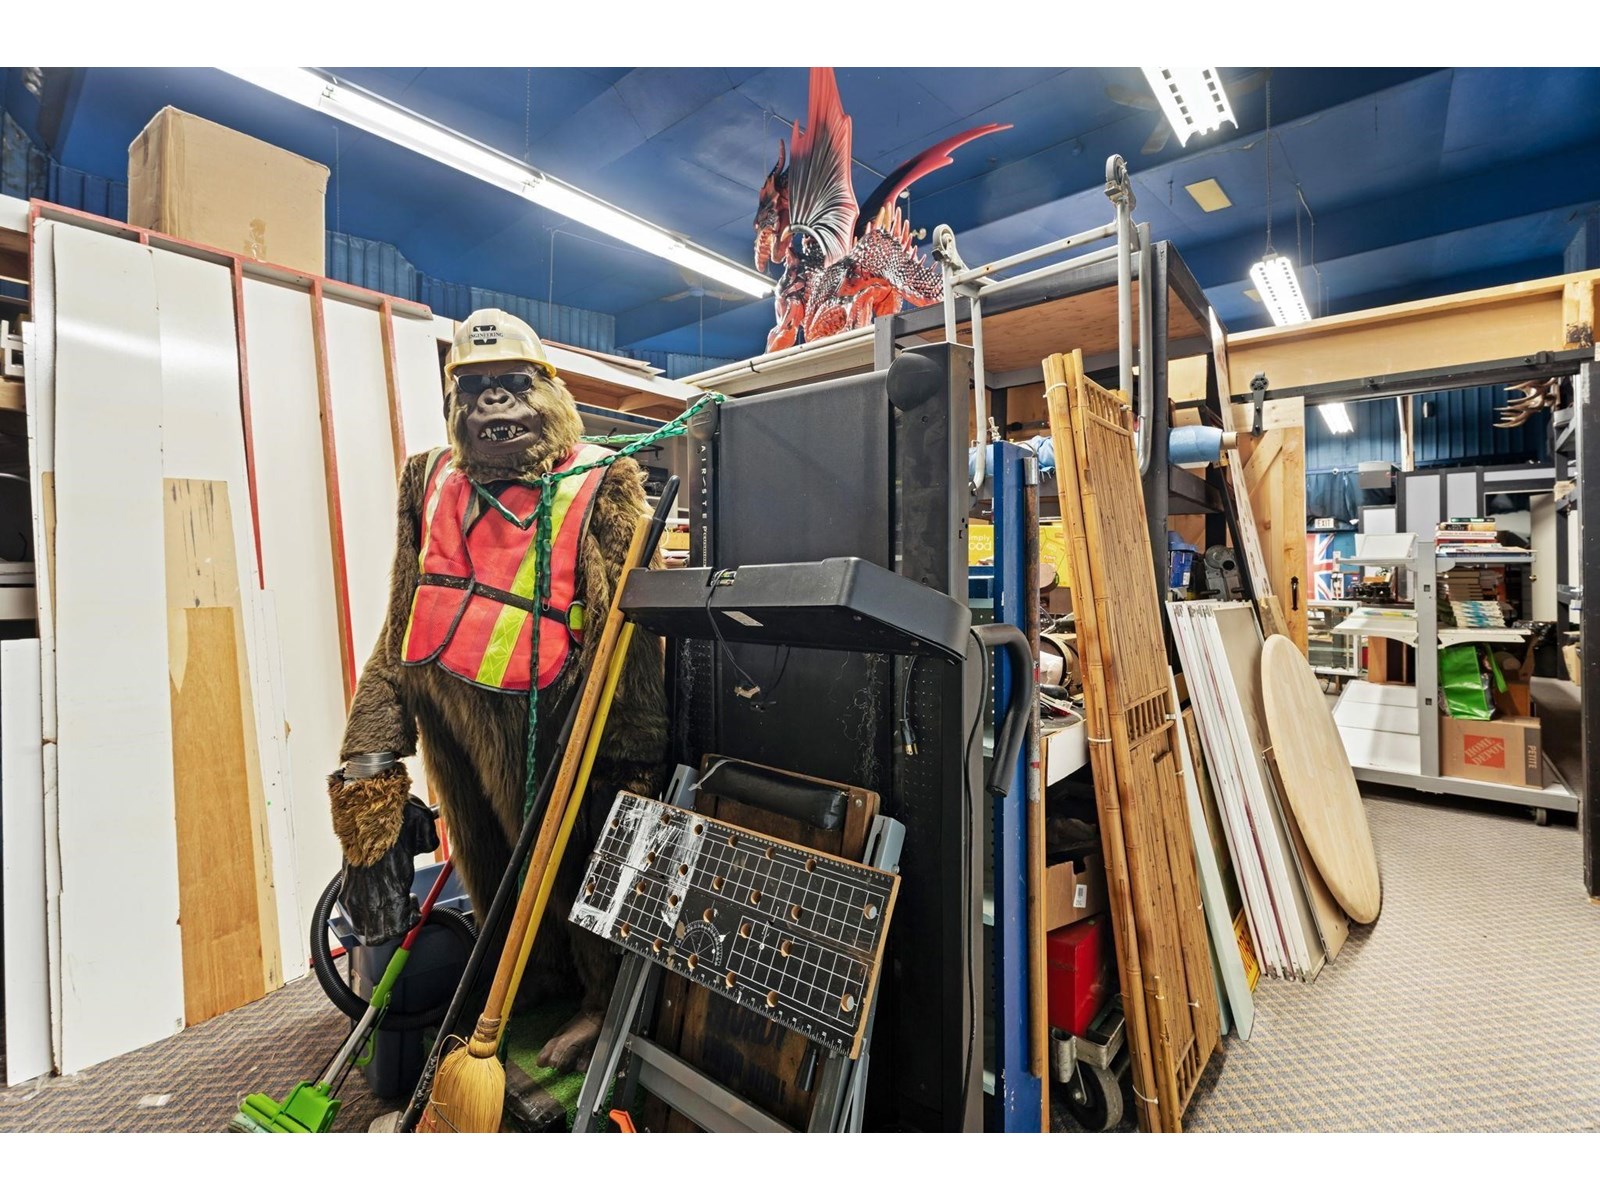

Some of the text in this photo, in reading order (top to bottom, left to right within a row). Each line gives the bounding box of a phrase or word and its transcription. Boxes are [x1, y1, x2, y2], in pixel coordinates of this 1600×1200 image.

[1317, 519, 1331, 527] EXIT
[968, 541, 992, 551] ood
[1464, 738, 1495, 758] HOME
[1472, 743, 1505, 766] DEPOT
[1527, 745, 1537, 769] PETITE
